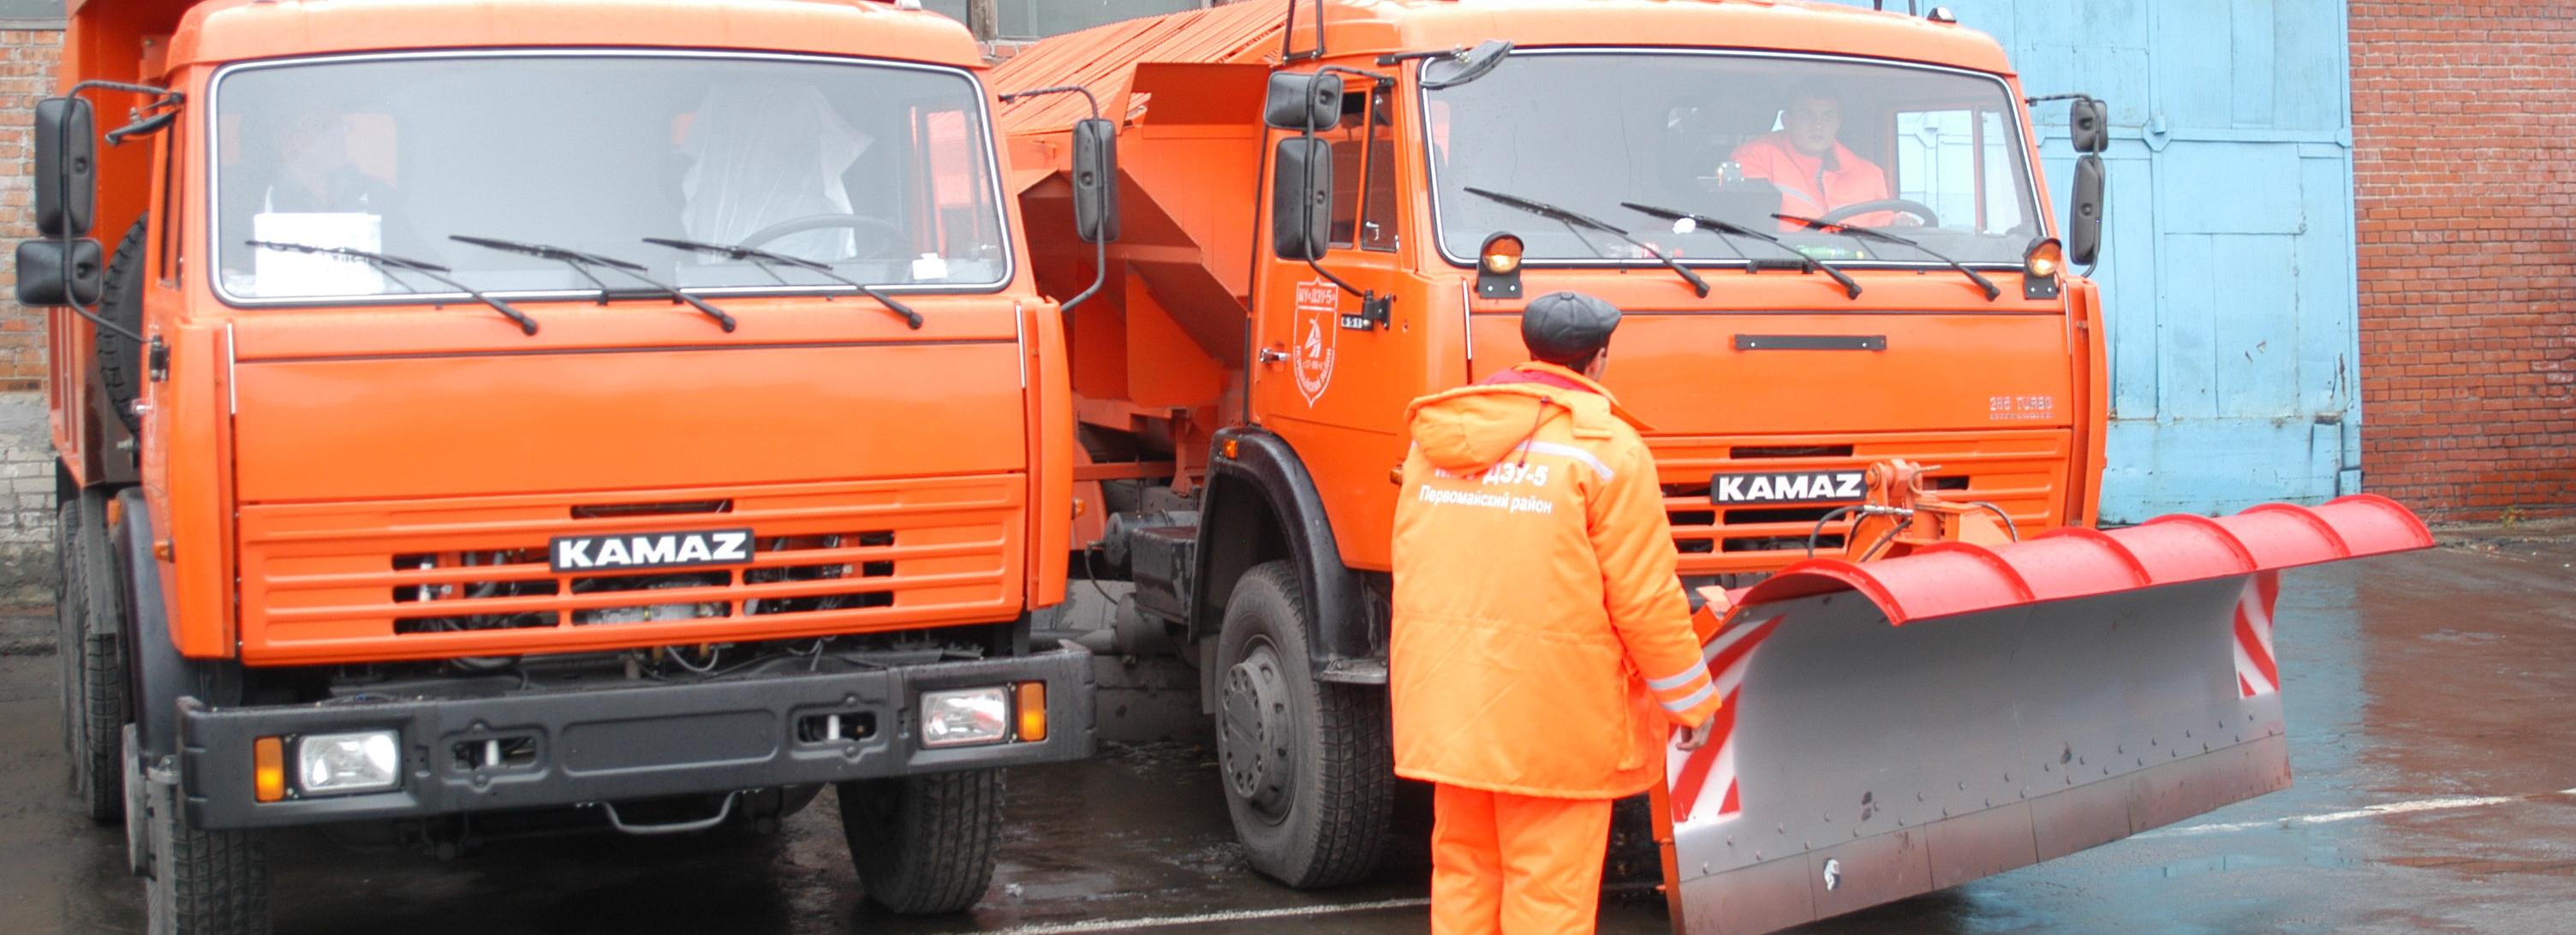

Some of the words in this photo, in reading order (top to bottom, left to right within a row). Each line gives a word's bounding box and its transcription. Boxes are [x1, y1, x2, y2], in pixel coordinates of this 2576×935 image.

[2015, 396, 2053, 410] TURBO
[1419, 485, 1509, 508] Первомайский
[1510, 495, 1553, 514] район
[1718, 473, 1862, 501] KAMAZ
[559, 532, 747, 569] KAMAZ
